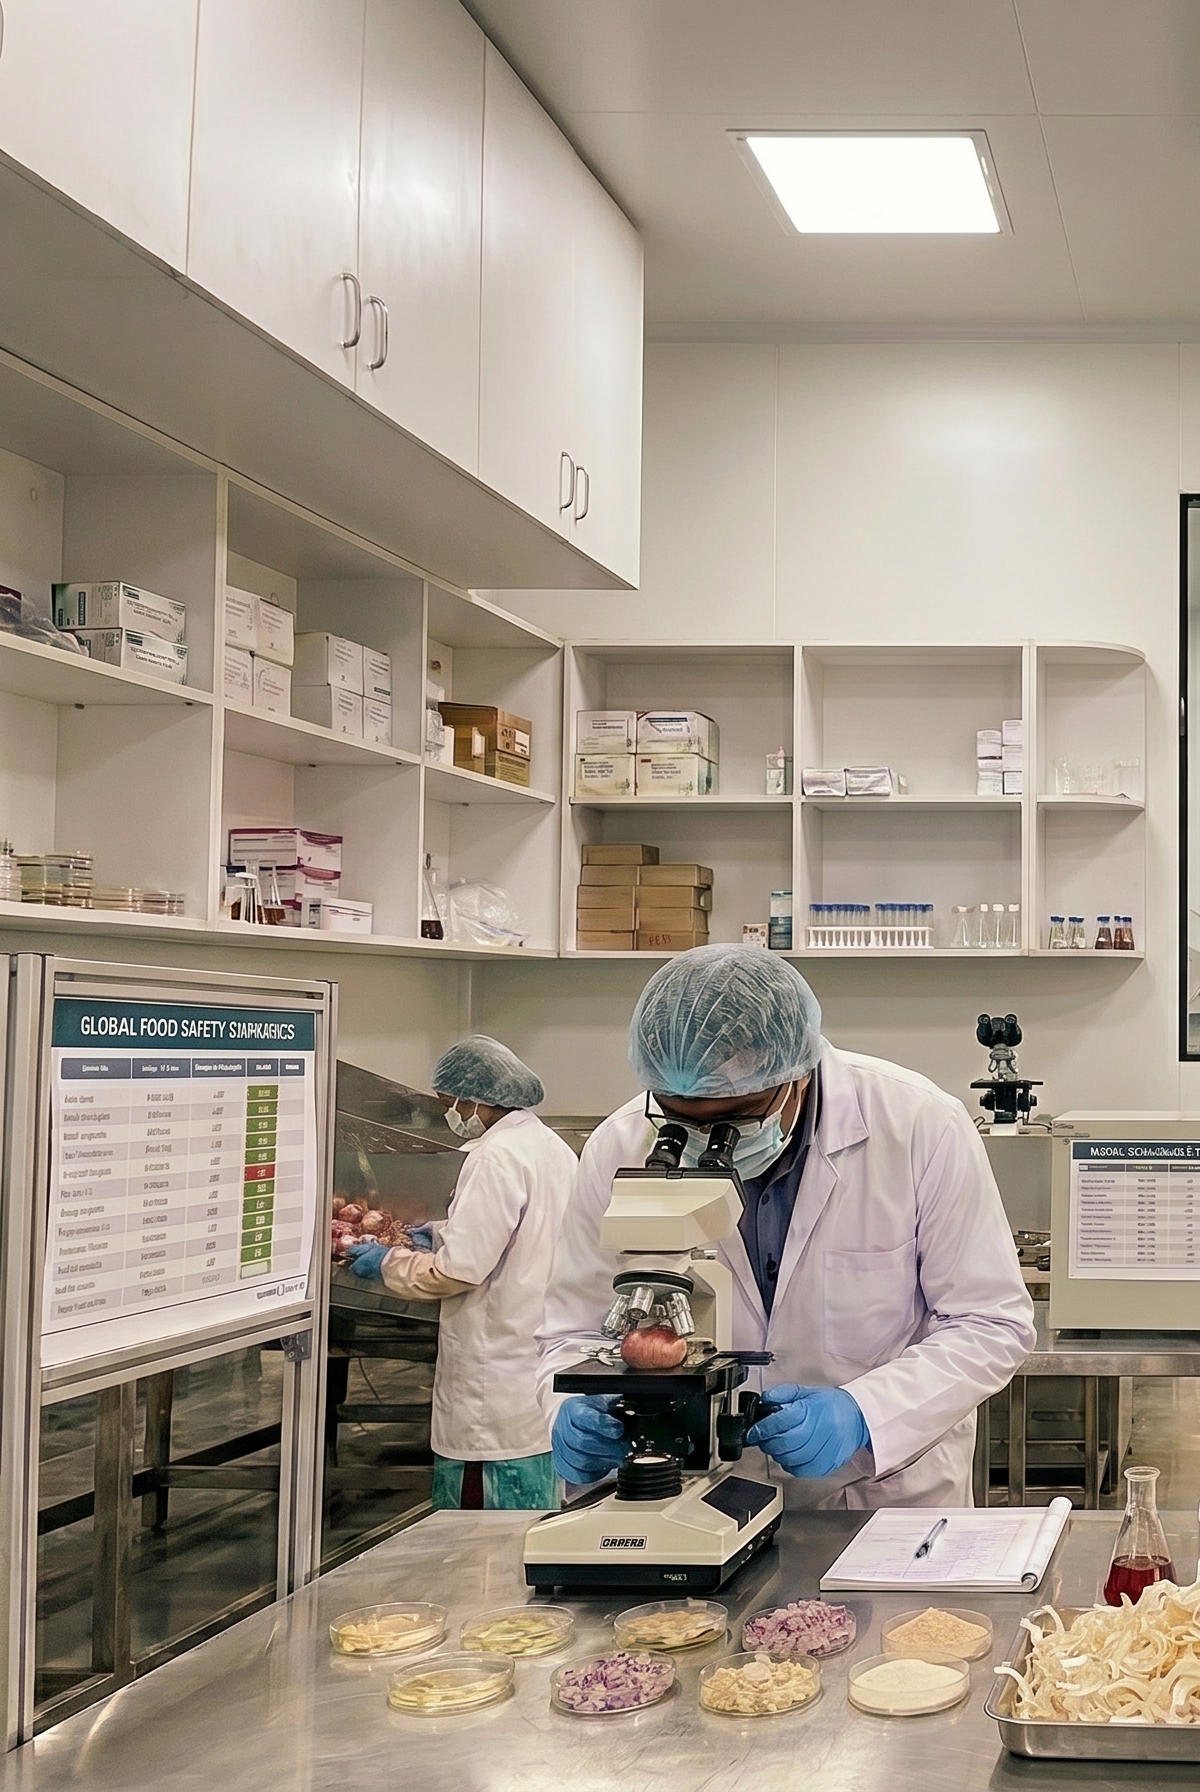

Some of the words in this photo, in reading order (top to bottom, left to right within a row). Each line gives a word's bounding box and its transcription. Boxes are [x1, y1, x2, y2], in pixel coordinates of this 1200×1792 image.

[80, 1015, 138, 1037] GLOBAL
[140, 1018, 178, 1037] FOOD
[181, 1019, 227, 1038] SAFETY
